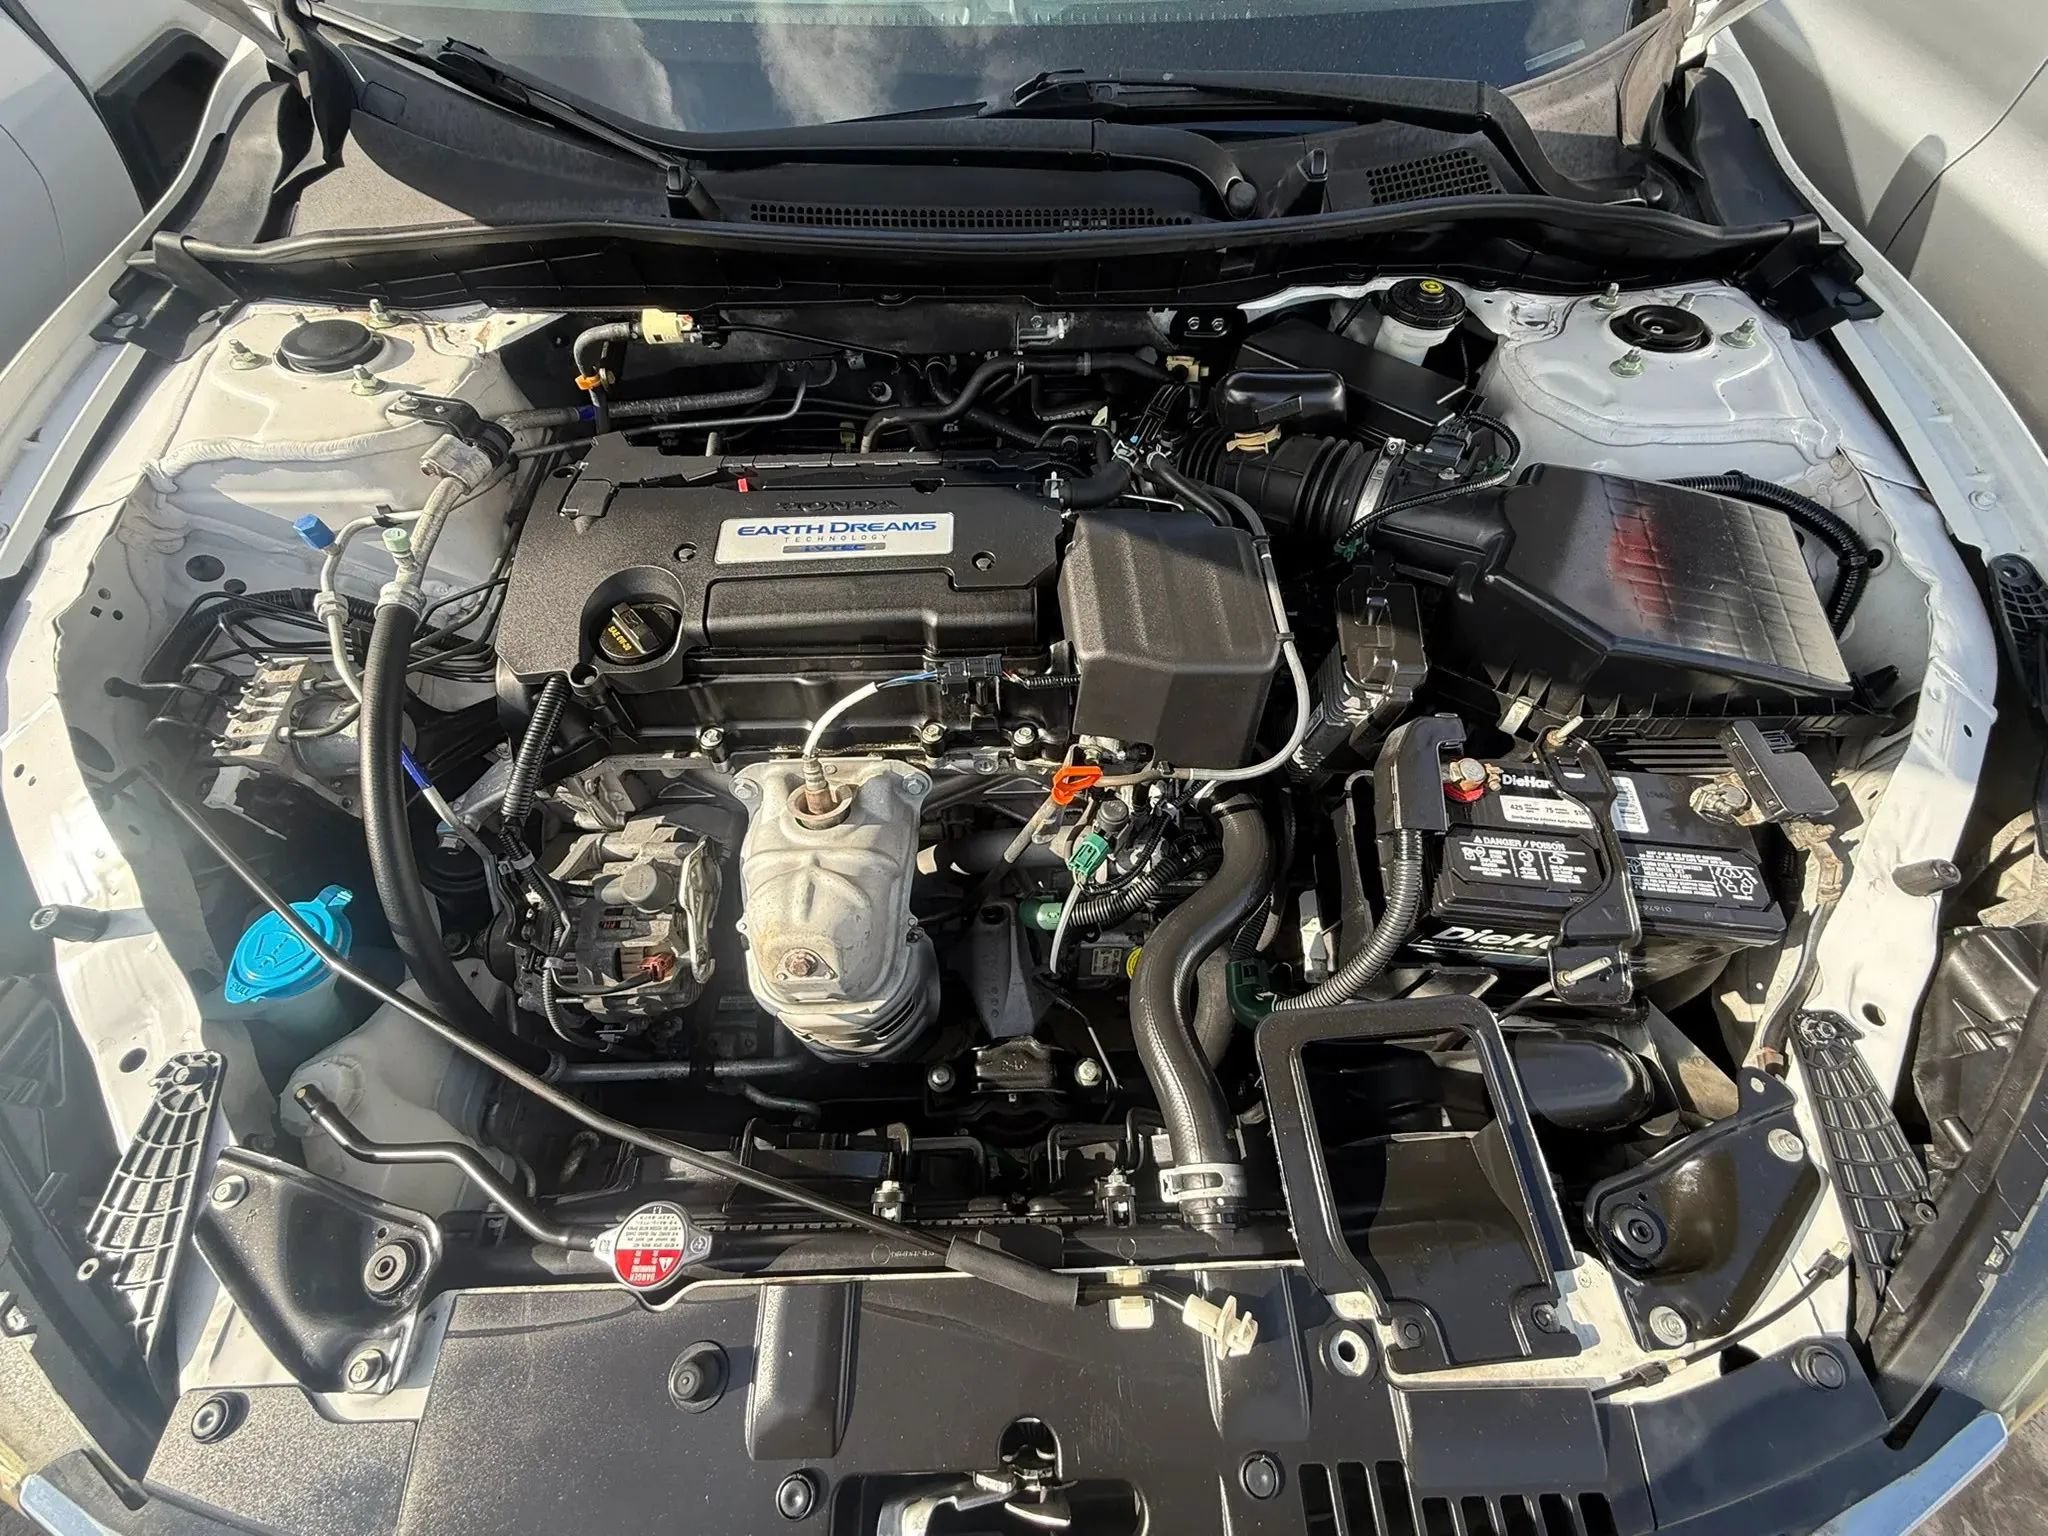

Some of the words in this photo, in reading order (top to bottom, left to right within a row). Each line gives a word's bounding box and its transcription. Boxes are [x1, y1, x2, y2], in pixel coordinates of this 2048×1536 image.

[776, 499, 900, 512] HONDA
[737, 523, 824, 536] EARTH
[829, 520, 937, 533] DREAMS
[784, 534, 888, 543] TECHNOLOGY
[607, 625, 621, 638] SAE
[1502, 773, 1556, 789] DieHar
[1510, 803, 1523, 811] 425
[1545, 806, 1554, 814] 75
[1483, 837, 1522, 847] DANGER
[1530, 840, 1566, 851] POISON
[230, 981, 252, 997] PULL
[630, 1272, 656, 1281] DANGER
